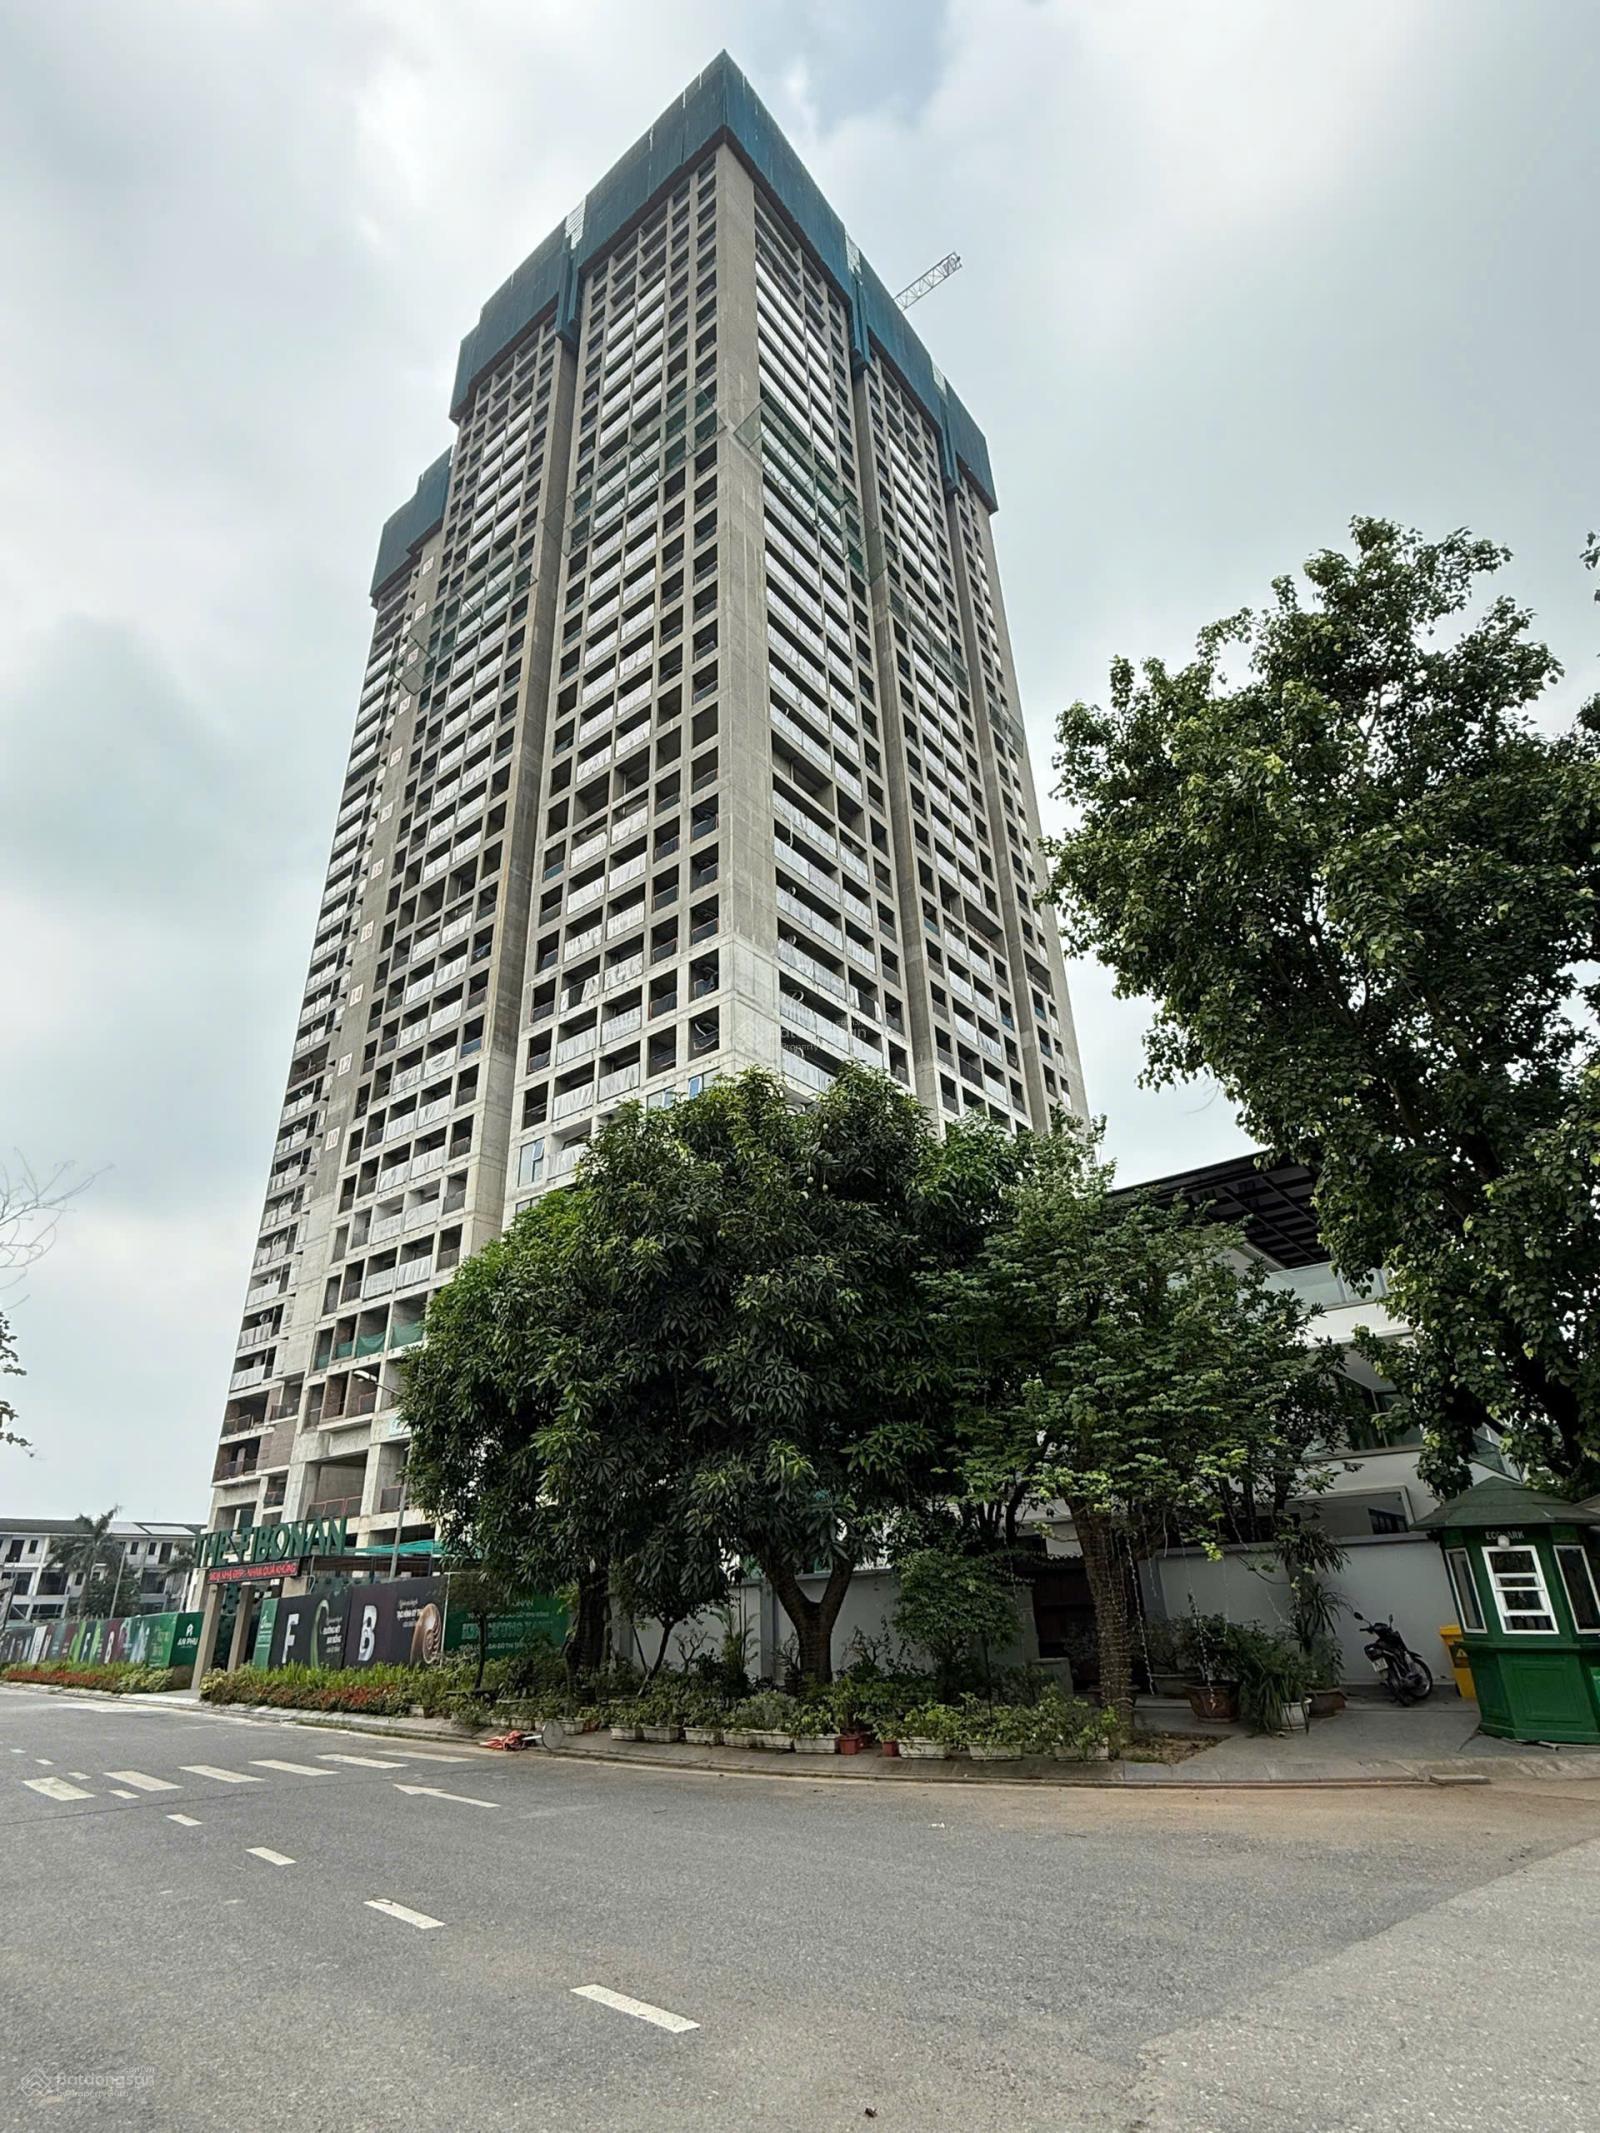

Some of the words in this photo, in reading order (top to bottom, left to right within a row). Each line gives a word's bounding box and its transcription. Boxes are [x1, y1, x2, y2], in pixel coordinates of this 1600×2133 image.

[340, 1056, 351, 1073] 12
[328, 1130, 338, 1148] 10
[195, 1530, 232, 1568] THE
[239, 1516, 347, 1563] FIBONAN
[1485, 1530, 1524, 1540] ECOARK
[282, 1613, 299, 1664] F
[358, 1605, 377, 1661] B
